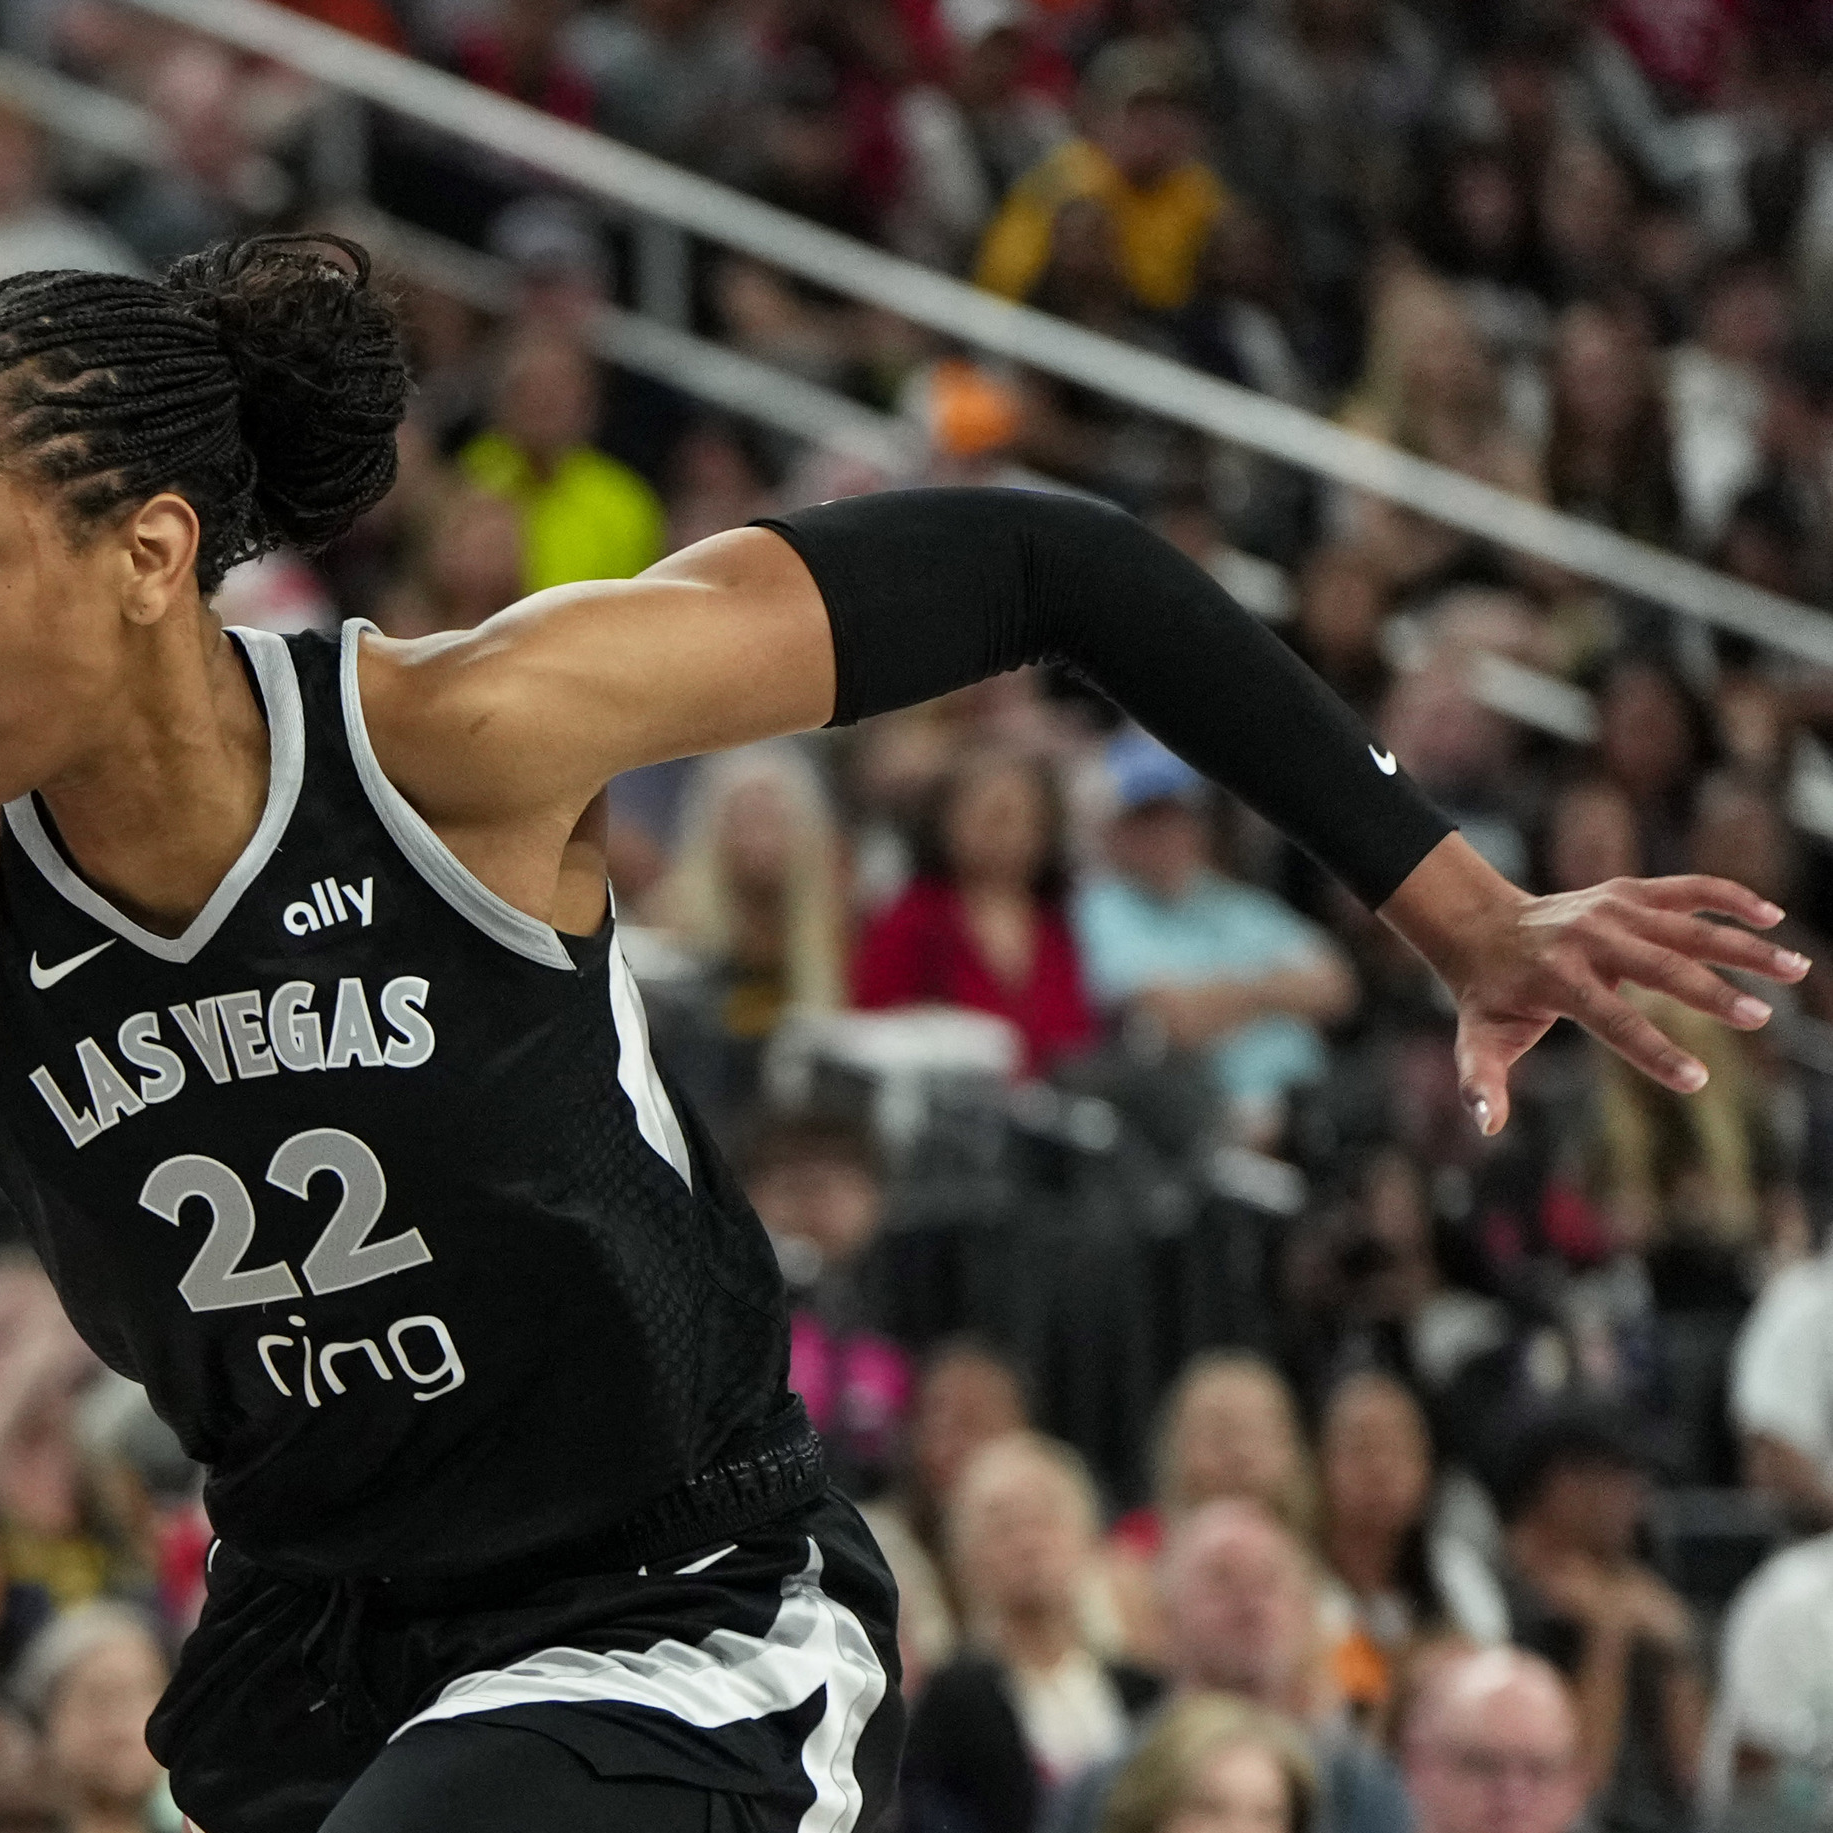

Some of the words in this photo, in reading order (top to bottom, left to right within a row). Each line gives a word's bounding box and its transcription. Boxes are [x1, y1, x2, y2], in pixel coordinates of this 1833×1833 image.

[282, 876, 374, 936] ally
[29, 1011, 186, 1149] LAS
[168, 976, 435, 1084] VEGAS
[138, 1127, 433, 1313] 22
[256, 1314, 466, 1408] ring
